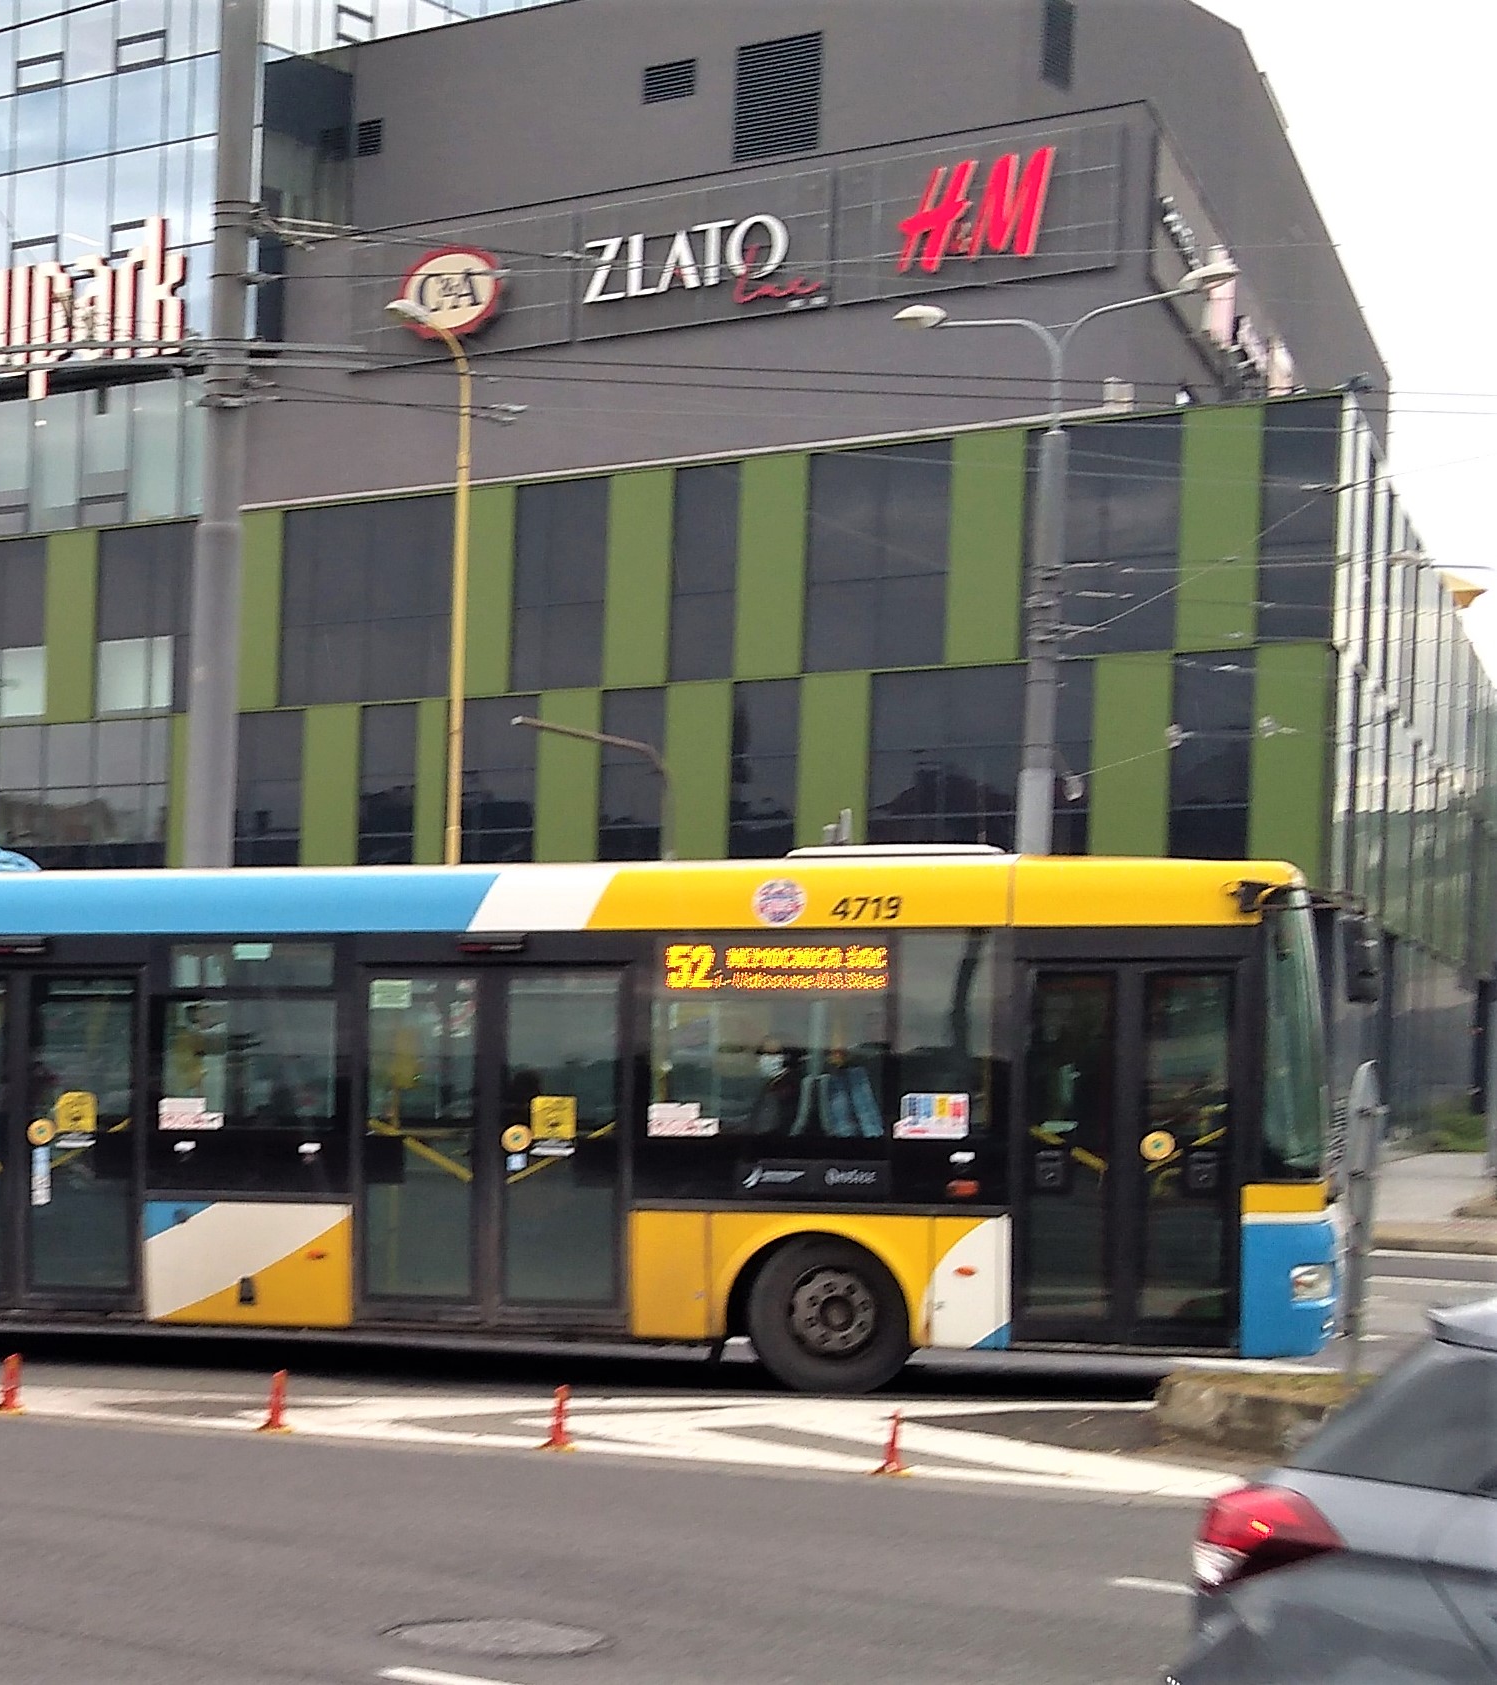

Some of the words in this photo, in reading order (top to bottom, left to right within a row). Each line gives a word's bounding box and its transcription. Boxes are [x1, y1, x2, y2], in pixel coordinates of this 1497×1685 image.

[896, 144, 1057, 274] H&M
[582, 213, 790, 305] ZLATO
[830, 895, 903, 921] 4719
[664, 944, 716, 989] 52
